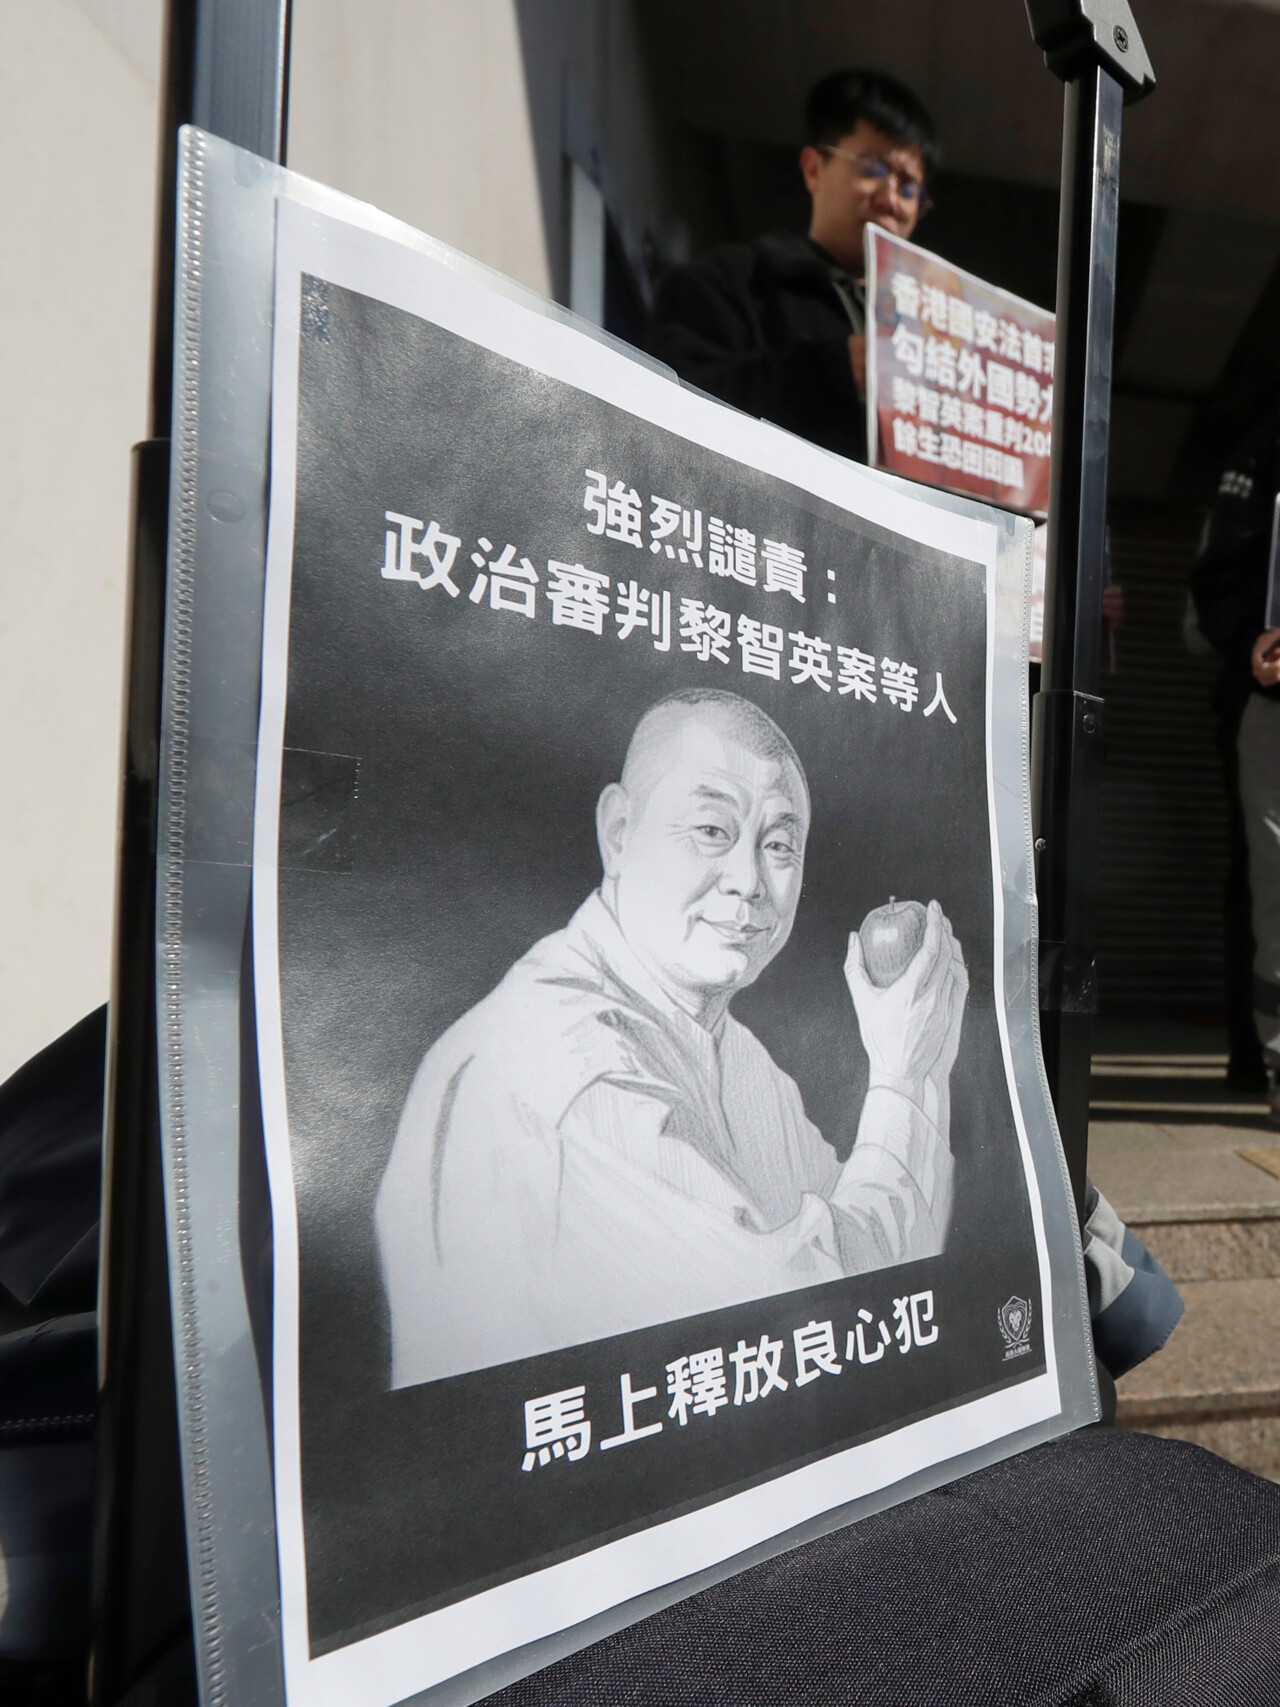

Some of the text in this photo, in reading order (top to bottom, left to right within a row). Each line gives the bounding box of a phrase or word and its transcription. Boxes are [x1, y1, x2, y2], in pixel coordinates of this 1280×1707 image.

[892, 376, 1051, 458] 黎智英案重判20
[380, 510, 958, 724] 政治審判黎智英案等人
[521, 1290, 939, 1472] 馬上釋放良心犯
